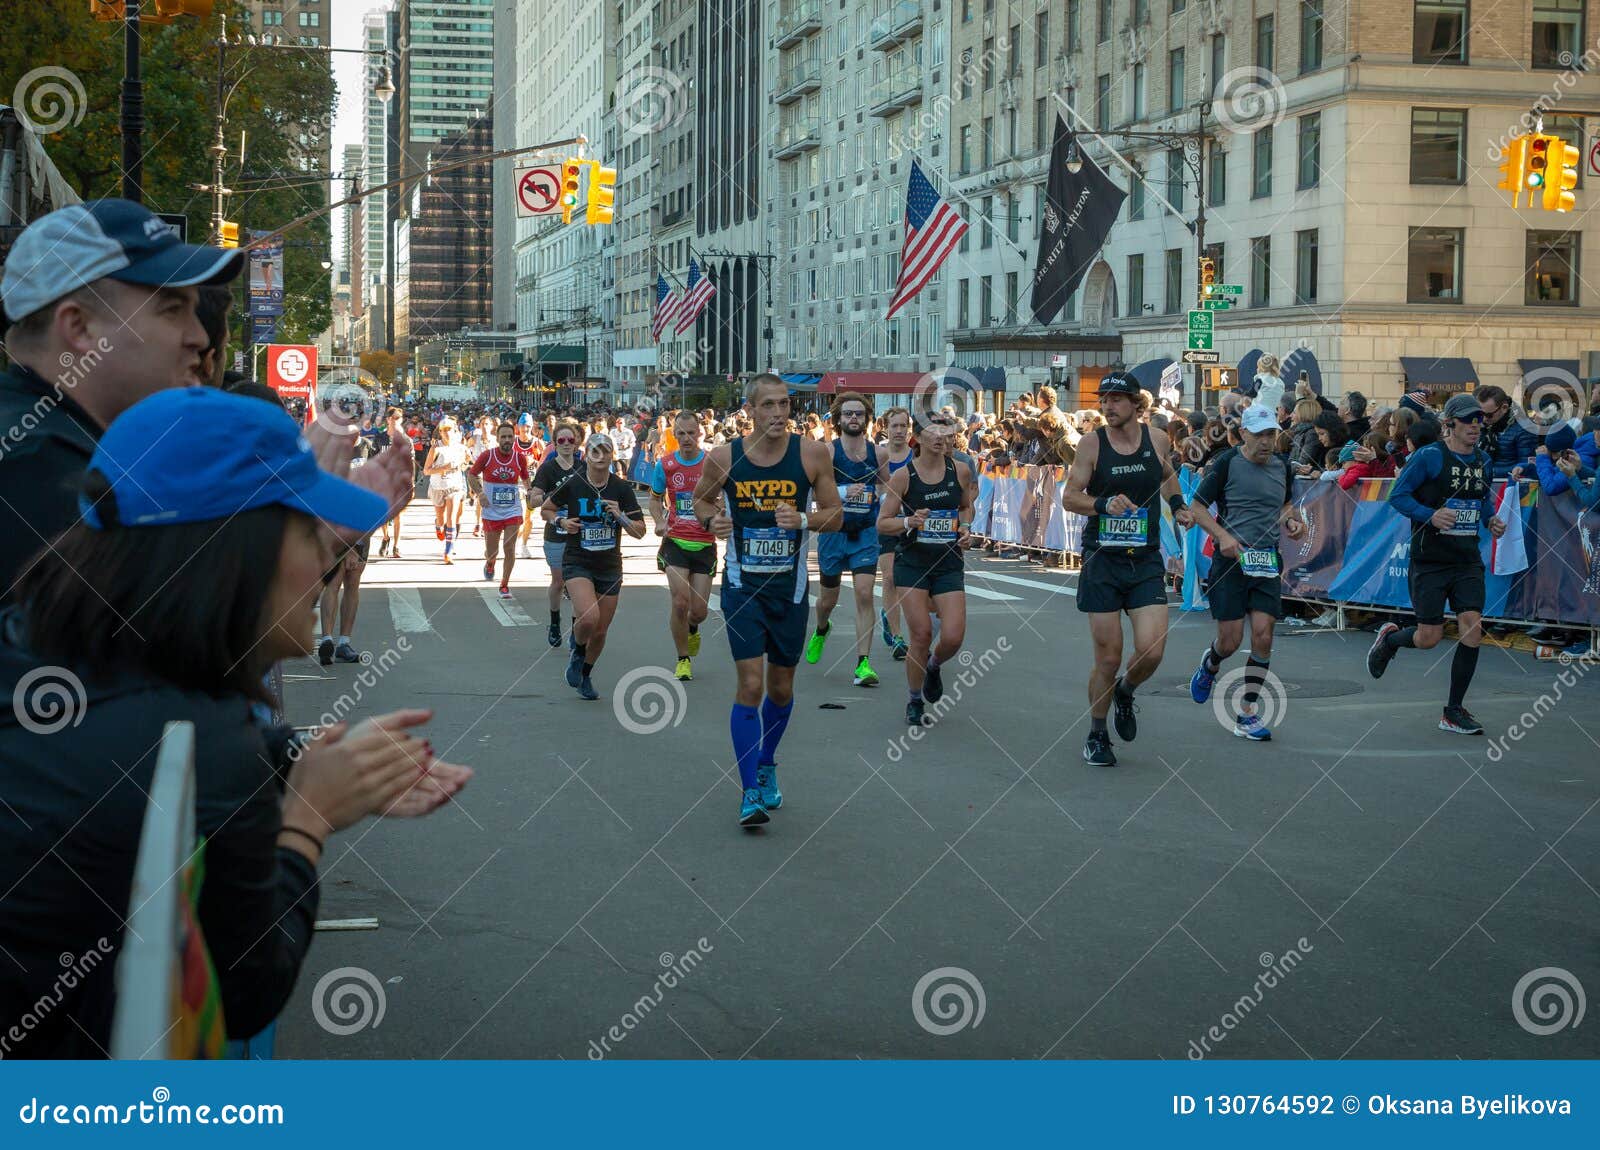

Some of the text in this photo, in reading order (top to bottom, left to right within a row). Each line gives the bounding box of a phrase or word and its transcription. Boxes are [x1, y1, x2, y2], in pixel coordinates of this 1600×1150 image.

[1047, 239, 1065, 265] RITZ
[1062, 187, 1091, 237] CARLTON
[1210, 302, 1215, 310] 6
[278, 385, 307, 393] Medical
[492, 466, 515, 478] ITALIA
[1111, 463, 1146, 475] STRAVA
[1451, 466, 1483, 478] RAW
[735, 480, 797, 498] NYPD
[924, 490, 950, 500] STRAVA
[928, 519, 949, 532] 14515
[1109, 519, 1138, 533] 17043
[589, 529, 607, 539] 9847
[755, 540, 783, 555] 7049
[1247, 552, 1270, 565] 16252
[1389, 566, 1409, 577] RUN
